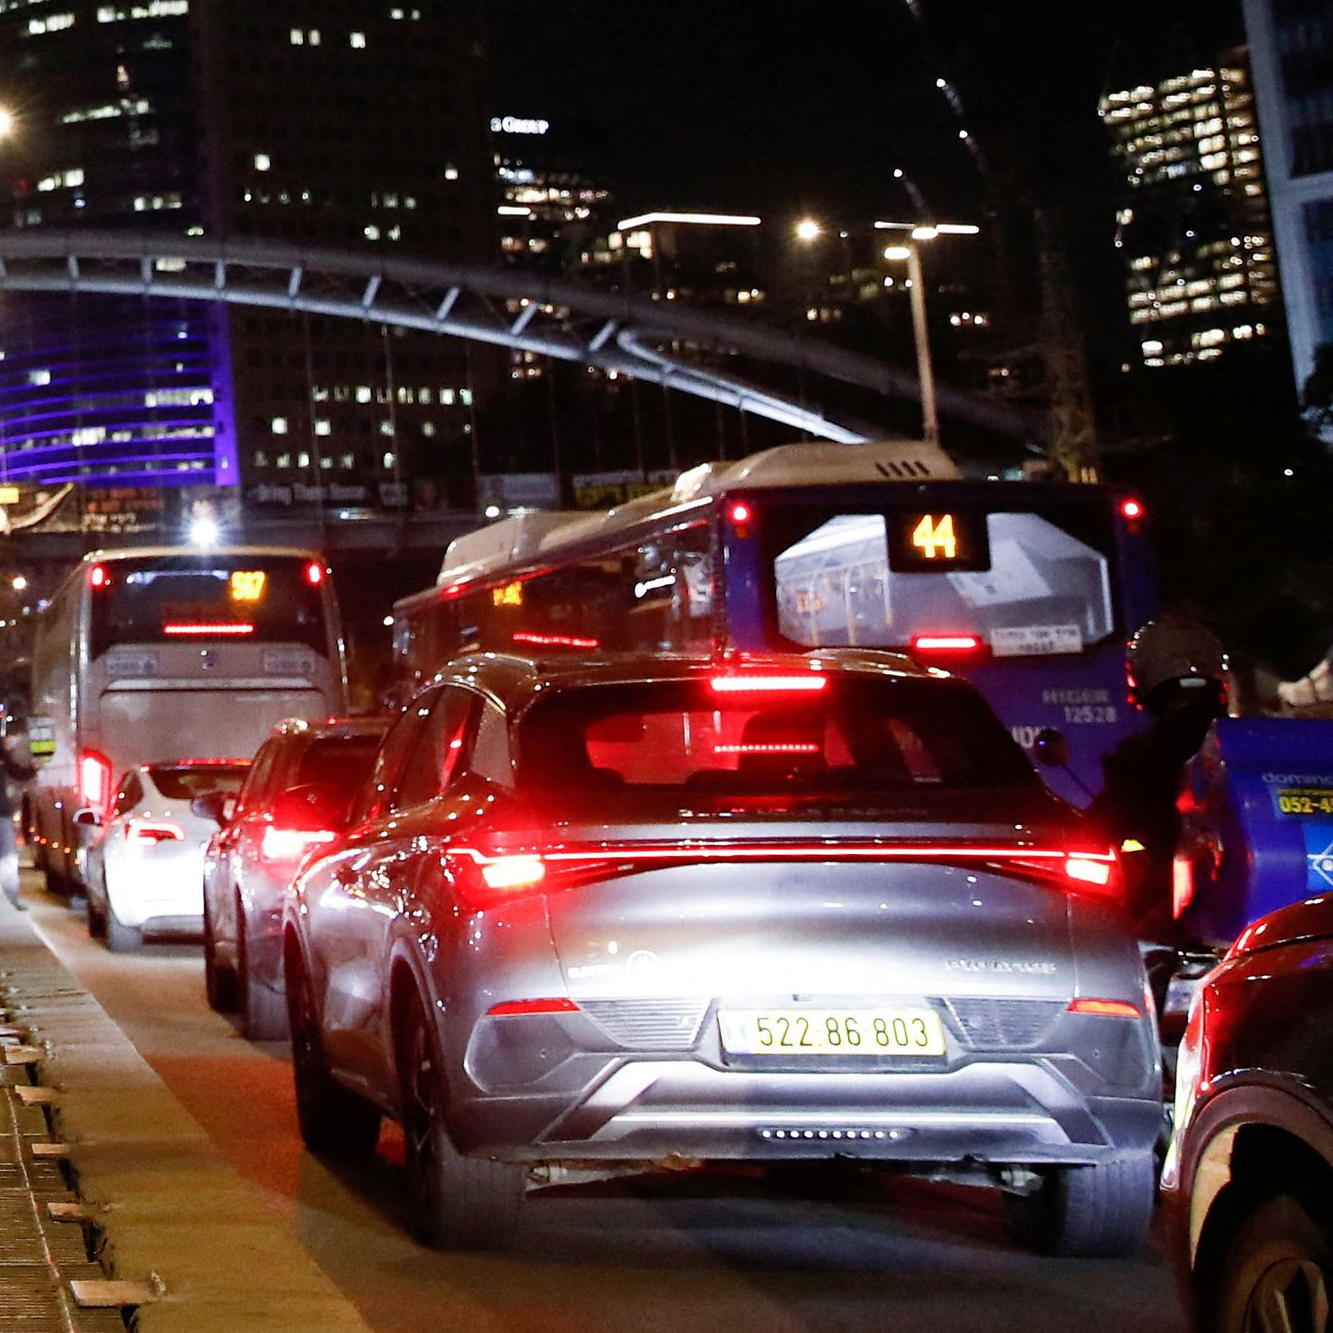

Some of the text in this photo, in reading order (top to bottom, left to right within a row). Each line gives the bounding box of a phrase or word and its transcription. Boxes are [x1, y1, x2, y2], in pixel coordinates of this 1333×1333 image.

[913, 514, 956, 558] 44
[756, 1017, 929, 1047] 522 86 803
